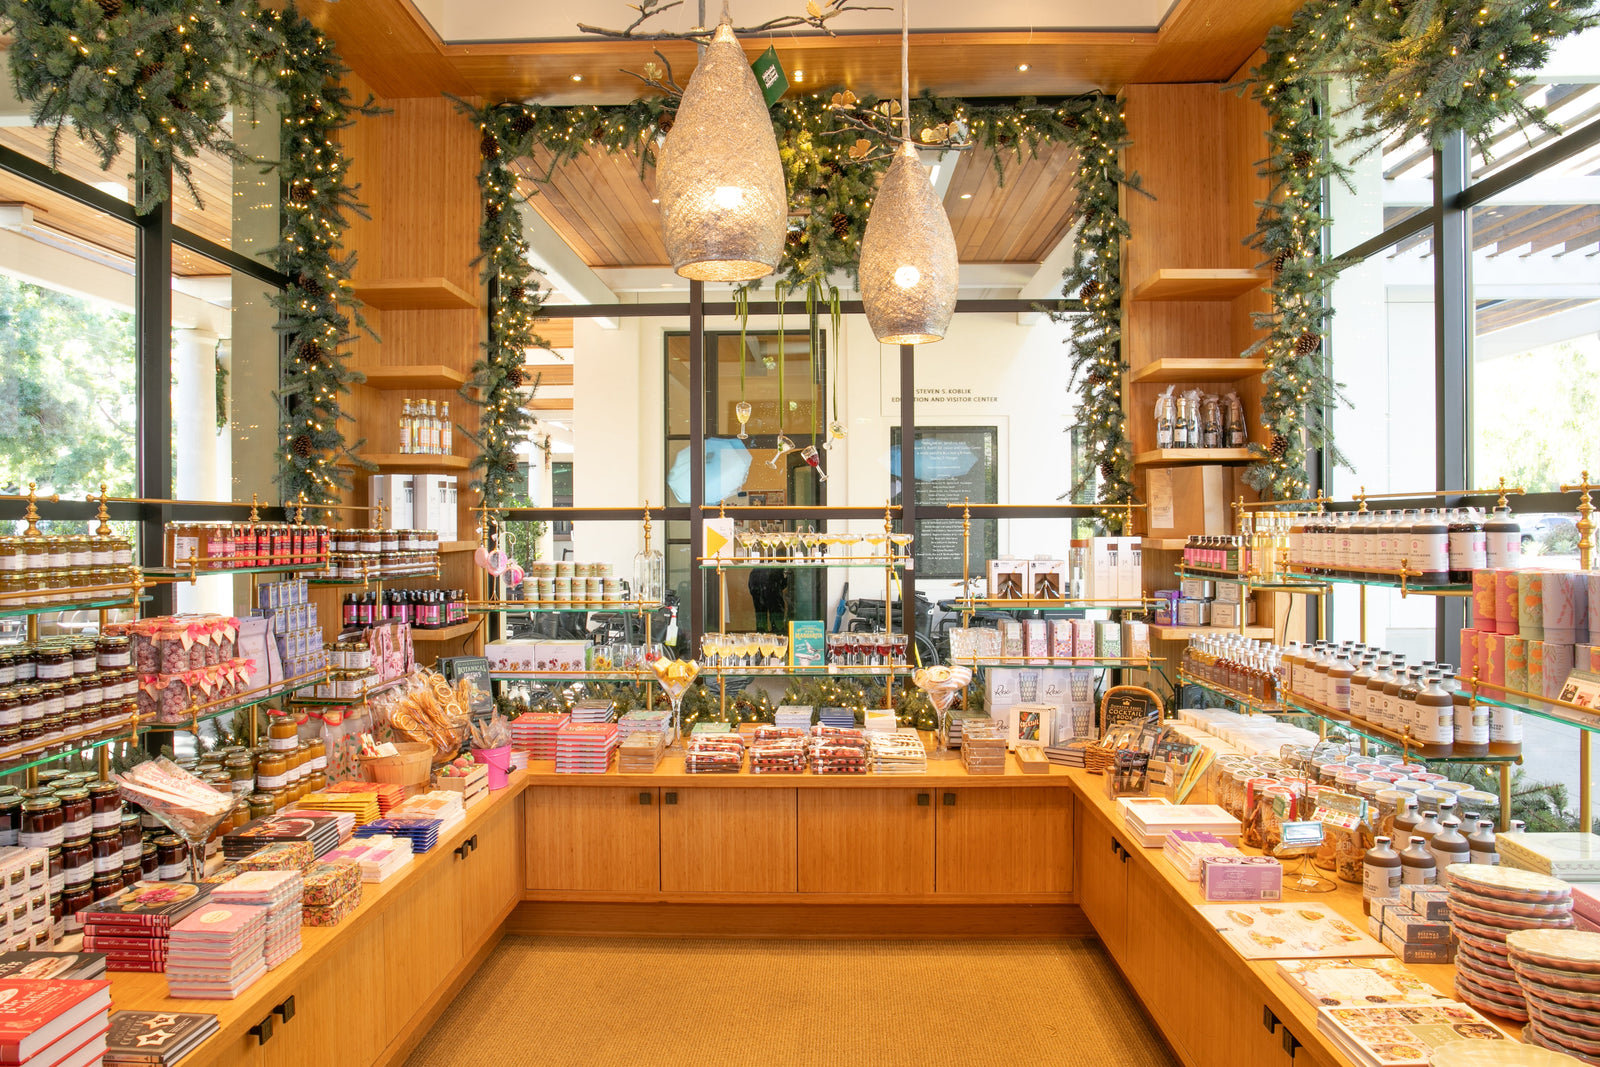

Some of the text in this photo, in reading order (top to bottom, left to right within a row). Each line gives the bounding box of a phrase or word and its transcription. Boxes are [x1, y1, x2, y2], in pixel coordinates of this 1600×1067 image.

[457, 664, 487, 675] BOTANICAL
[1108, 708, 1142, 718] COCKTAIL
[1019, 719, 1040, 728] COCKTAIL
